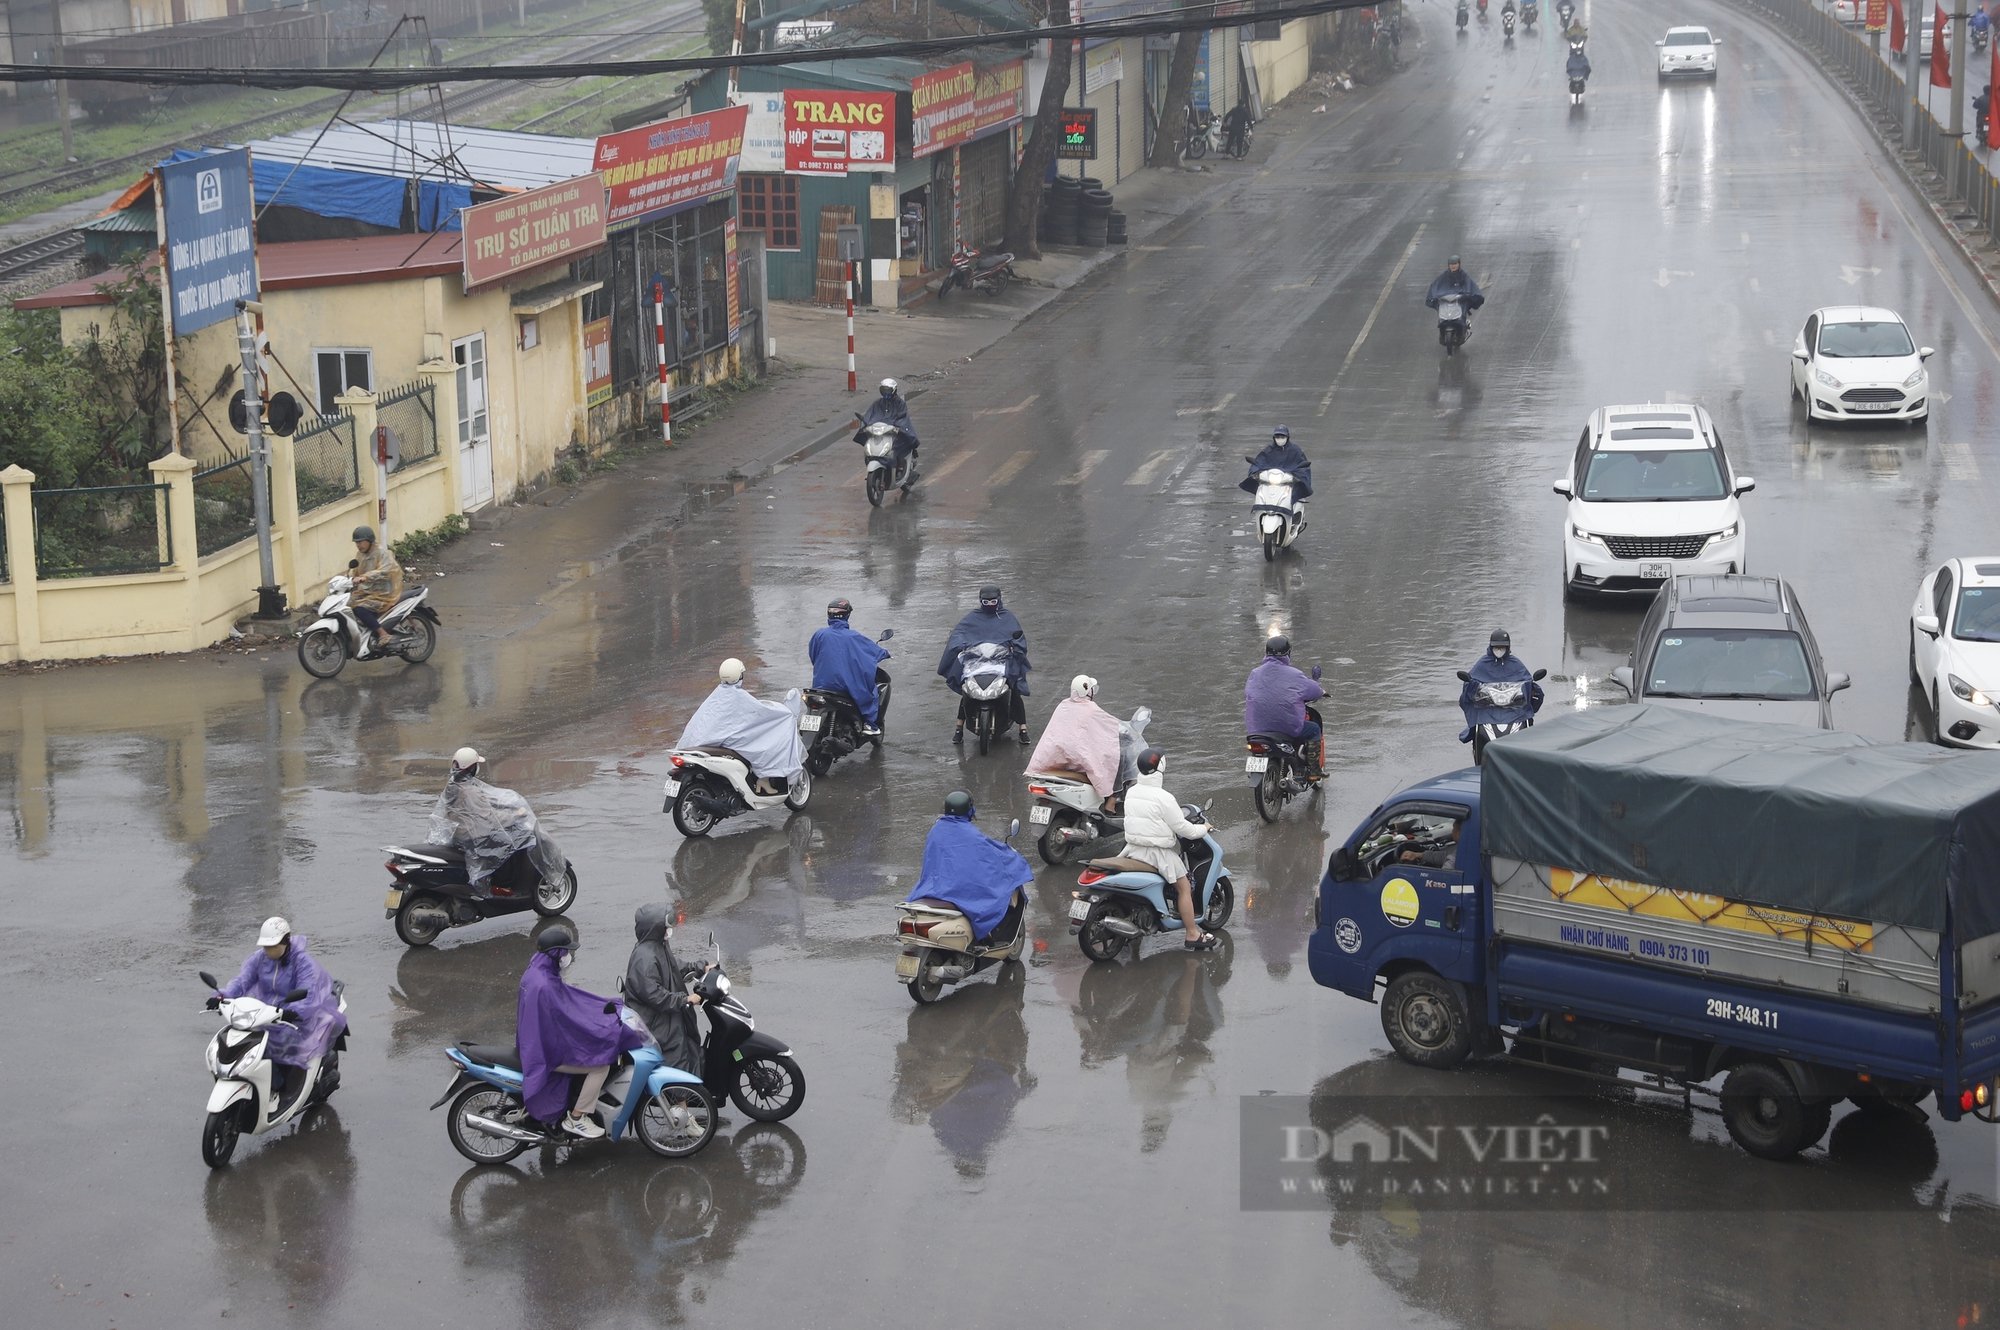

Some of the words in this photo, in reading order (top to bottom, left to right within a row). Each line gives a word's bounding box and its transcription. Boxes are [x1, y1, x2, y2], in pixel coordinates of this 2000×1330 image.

[940, 78, 953, 101] NAM
[793, 100, 884, 125] TRANG
[789, 128, 808, 147] HỘP
[822, 162, 832, 170] 731
[495, 208, 515, 223] UBND
[517, 204, 528, 217] THỊ
[475, 232, 504, 258] TRỤ
[509, 218, 529, 249] SỞ
[533, 208, 570, 242] TUẦN
[574, 203, 599, 228] TRA
[189, 241, 199, 270] LẠI
[522, 247, 540, 262] DÂN
[560, 238, 570, 250] GA
[1561, 925, 1584, 946] NHẬN
[1606, 930, 1629, 951] HÀNG
[1640, 939, 1665, 957] 0904
[1669, 944, 1688, 961] 373
[1692, 949, 1710, 965] 101
[1706, 999, 1778, 1029] 29H-348.11
